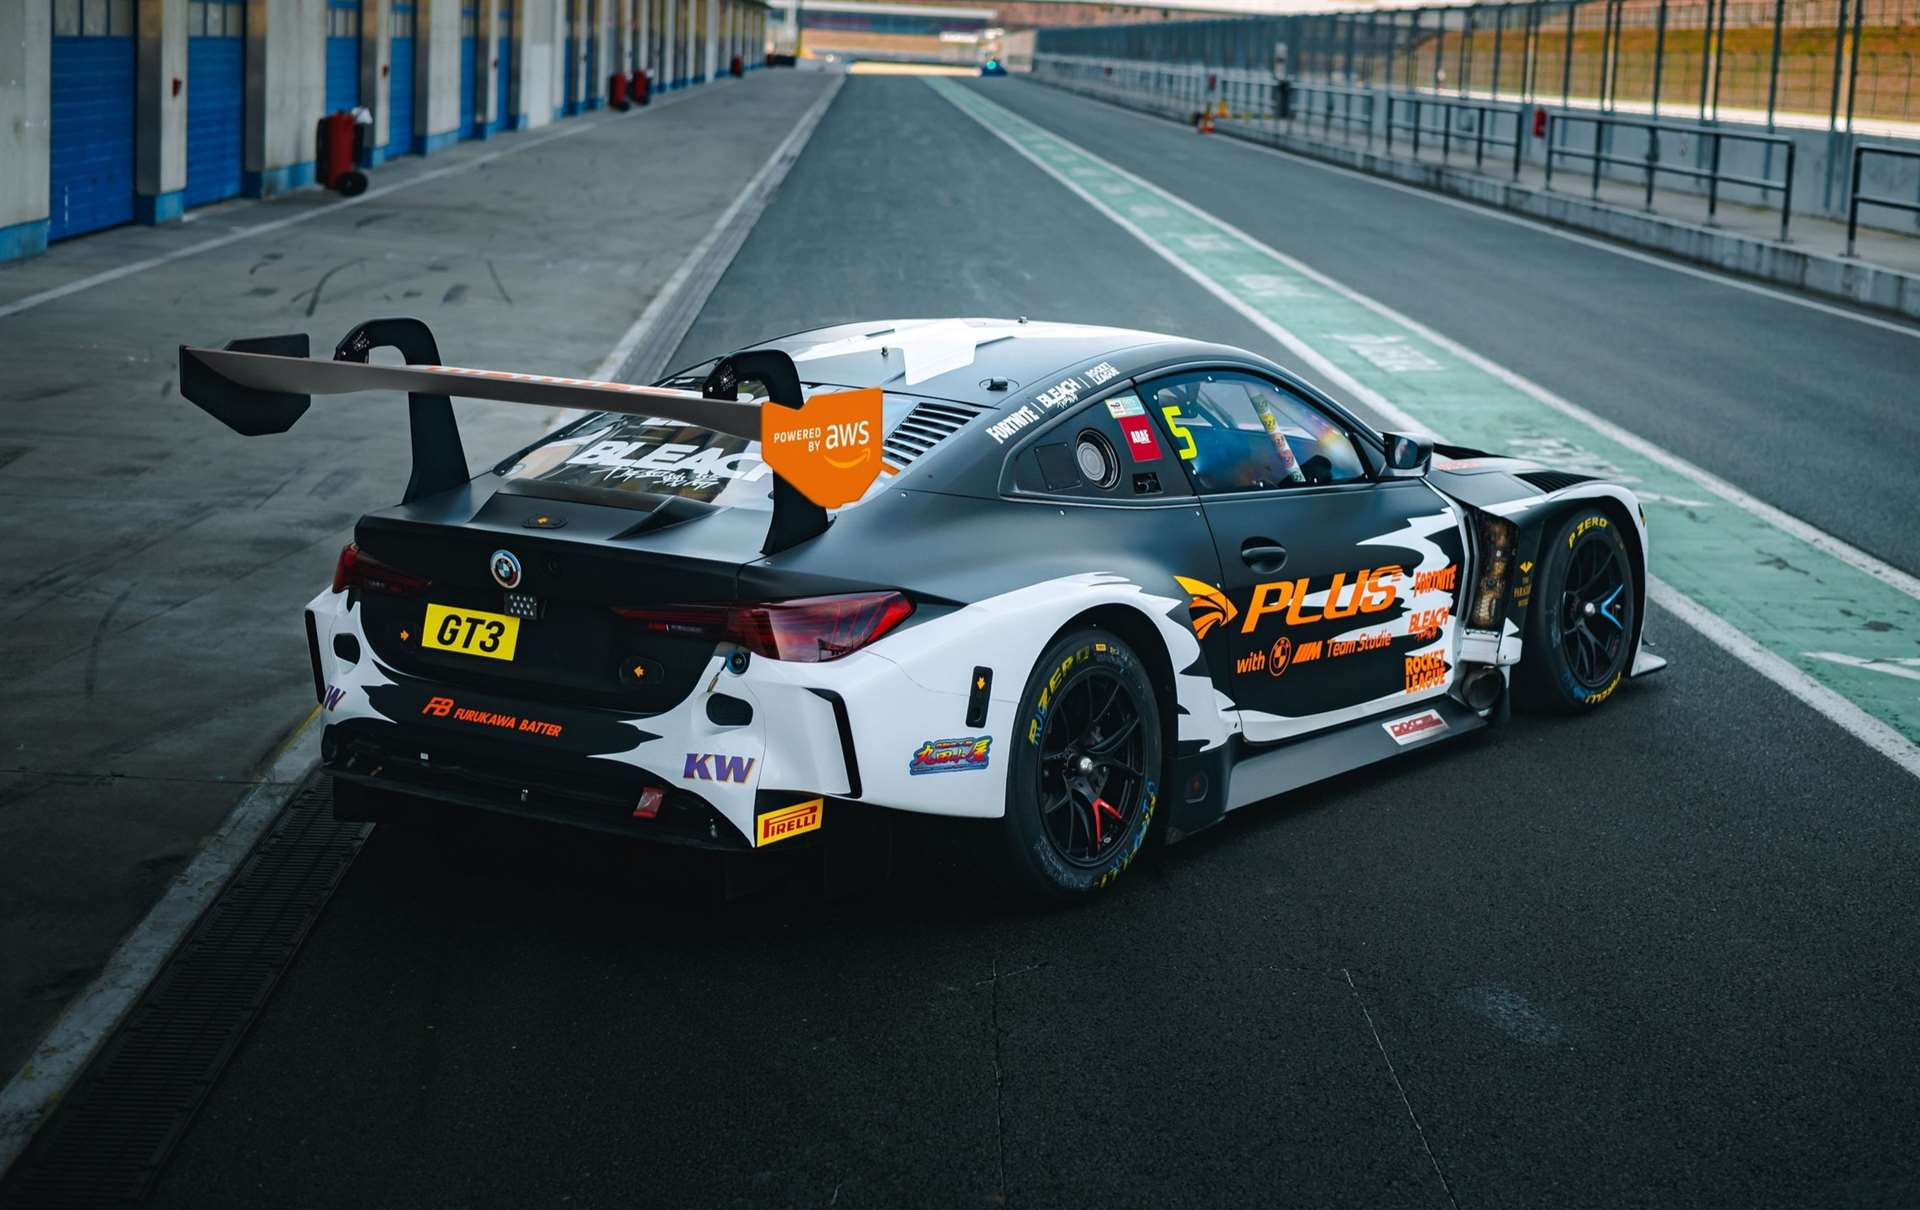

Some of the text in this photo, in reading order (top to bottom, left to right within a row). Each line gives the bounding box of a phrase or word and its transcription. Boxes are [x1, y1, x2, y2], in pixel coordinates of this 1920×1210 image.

[985, 405, 1041, 445] FORTNITE
[1036, 378, 1081, 408] BLEACH
[773, 427, 822, 443] POWERED
[808, 440, 821, 452] BY
[825, 420, 870, 450] aws
[1161, 404, 1198, 461] 5
[1568, 516, 1608, 550] P ZERO
[1412, 563, 1457, 598] FORTNITE
[1241, 564, 1403, 634] PLUS
[436, 614, 505, 653] GT3
[1408, 606, 1451, 634] BLEACH
[1237, 650, 1265, 674] with
[1327, 638, 1357, 659] Team
[1358, 629, 1393, 653] Studie
[1405, 648, 1446, 676] ROCKET
[1405, 666, 1446, 695] LEAGUE
[422, 696, 454, 717] FB
[453, 708, 517, 729] FURUKAWA
[682, 753, 756, 785] KW
[762, 805, 818, 839] PIRELLI
